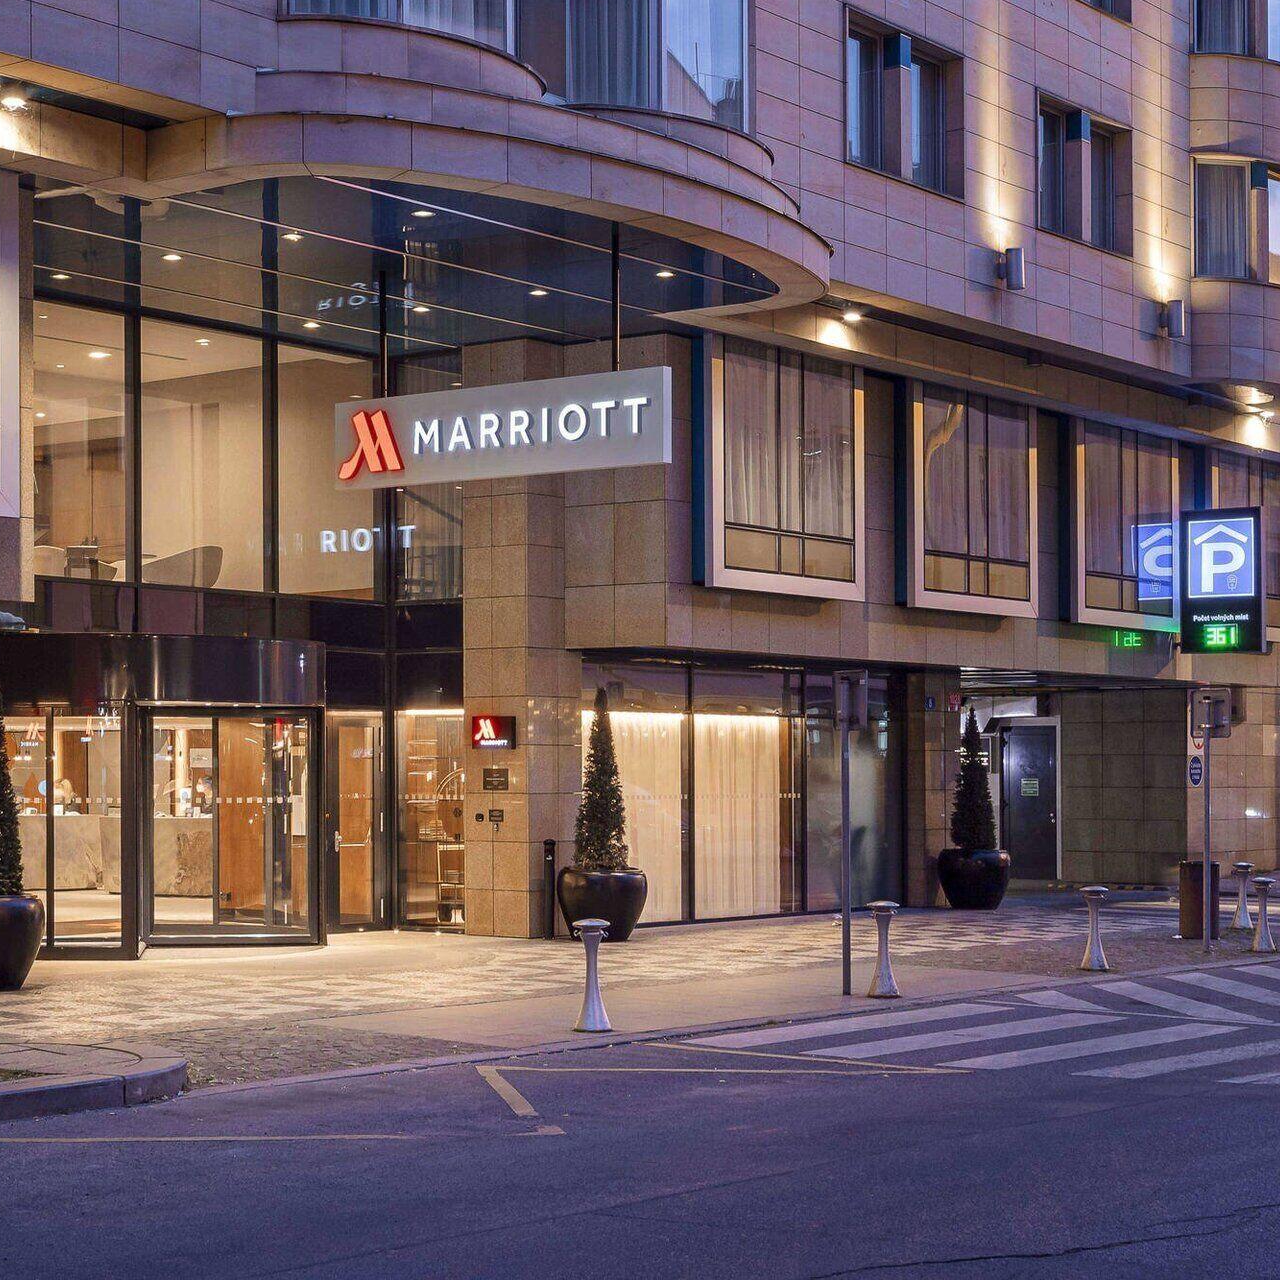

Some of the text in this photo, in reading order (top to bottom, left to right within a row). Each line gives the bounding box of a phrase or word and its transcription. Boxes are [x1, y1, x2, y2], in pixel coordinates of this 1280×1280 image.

[413, 397, 650, 455] MARRIOTT
[1201, 542, 1246, 593] P
[1206, 626, 1236, 646] 361
